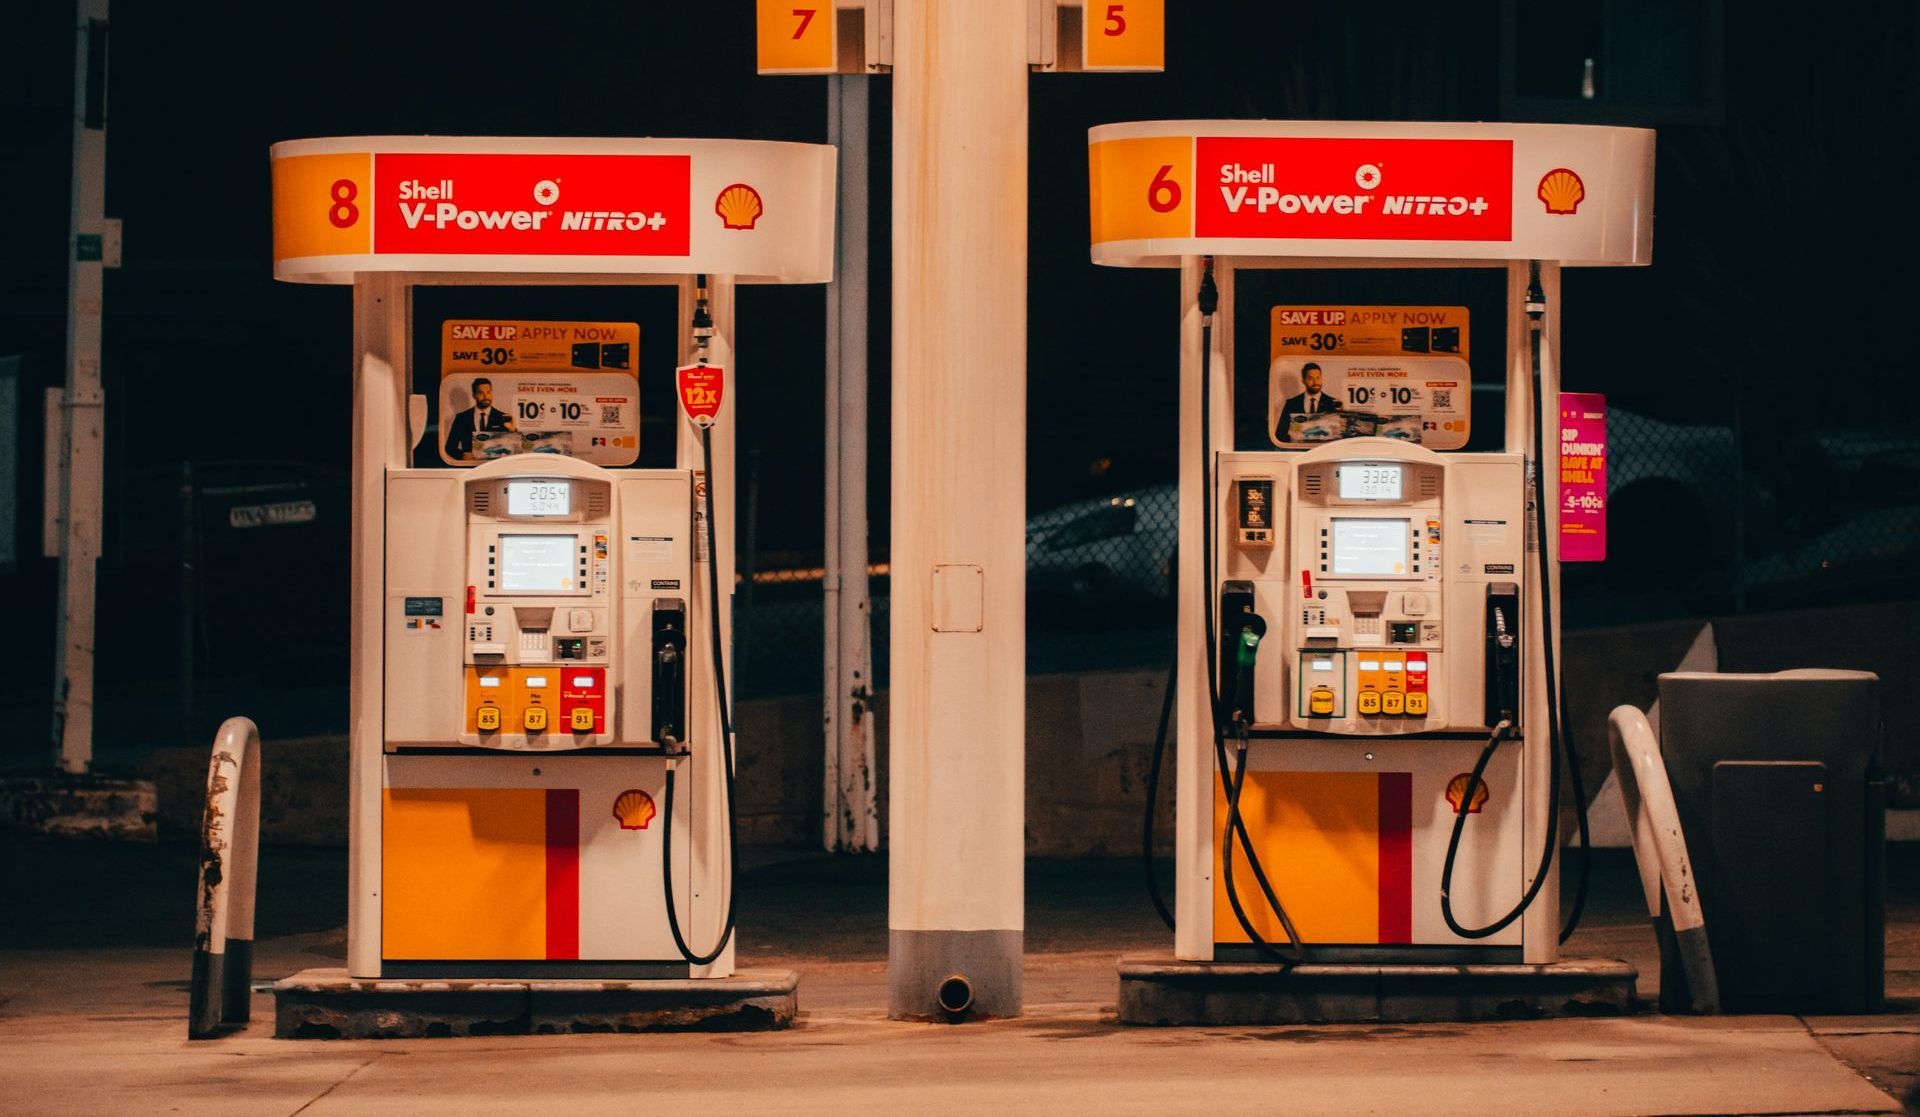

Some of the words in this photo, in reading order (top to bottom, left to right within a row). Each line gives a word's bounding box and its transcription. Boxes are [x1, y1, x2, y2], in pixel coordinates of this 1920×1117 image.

[792, 10, 816, 40] 7
[1104, 5, 1126, 37] 5
[1220, 164, 1274, 184] Shell
[399, 180, 453, 199] Shell
[1148, 165, 1181, 212] 6
[329, 179, 359, 229] 8
[1220, 186, 1369, 215] V-Power
[399, 203, 545, 231] V-Power
[1281, 311, 1318, 325] SAVE
[1351, 312, 1397, 325] APPLY
[1403, 312, 1446, 325] NOW
[452, 325, 489, 340] SAVE
[522, 327, 567, 340] APPLY
[574, 328, 616, 341] NOW
[1281, 337, 1307, 346] SAVE
[452, 351, 478, 361] SAVE
[685, 387, 717, 404] 12x
[1562, 428, 1578, 441] SIP
[1562, 456, 1587, 469] SAVE
[1590, 457, 1604, 469] AT
[1562, 470, 1594, 483] SHELL
[1363, 699, 1377, 707] 85
[1386, 699, 1400, 707] 87
[1410, 699, 1423, 707] 91
[482, 715, 495, 723] 85
[529, 715, 542, 723] 87
[576, 715, 588, 724] 91
